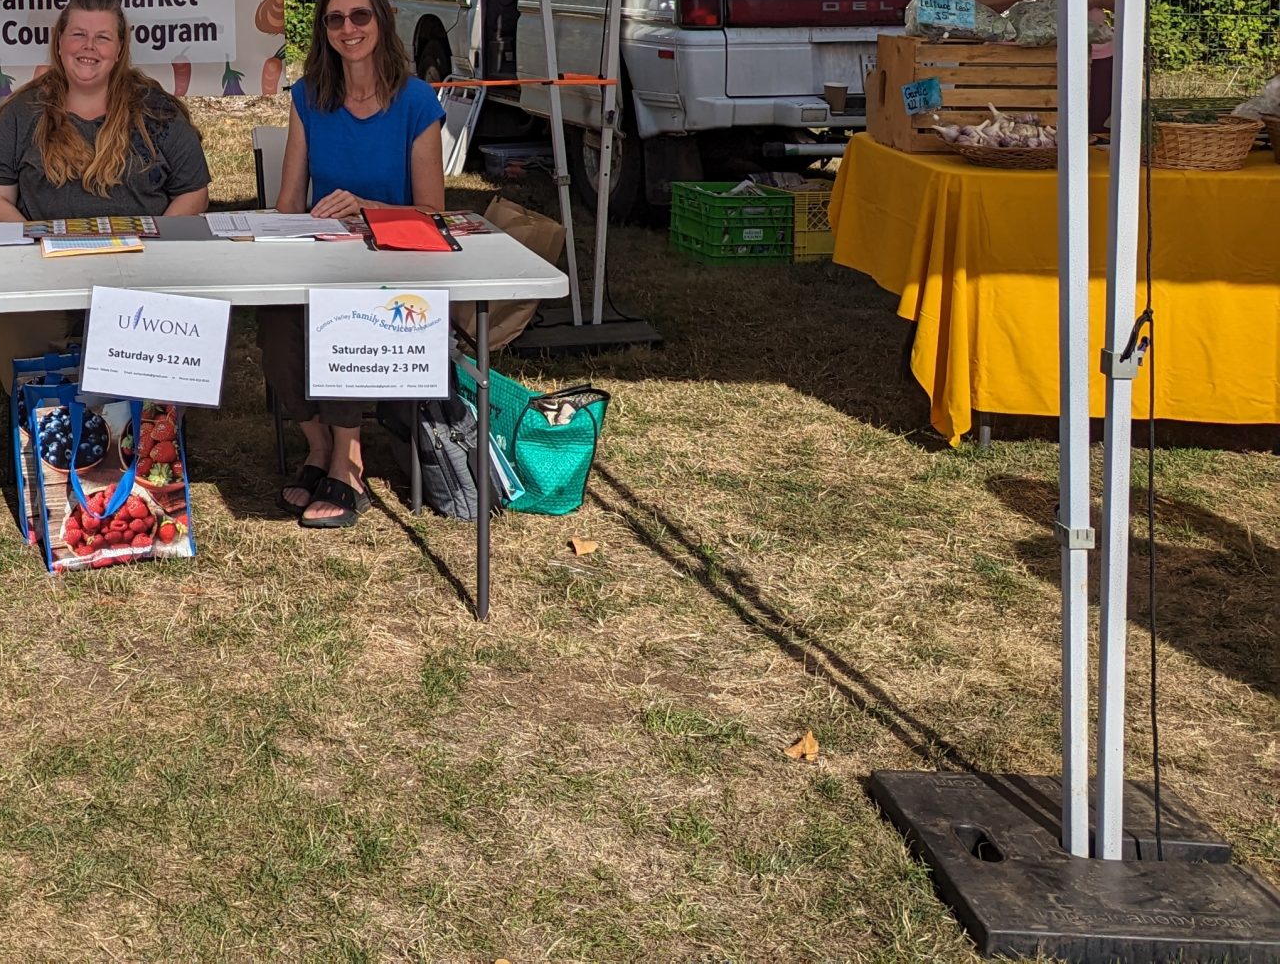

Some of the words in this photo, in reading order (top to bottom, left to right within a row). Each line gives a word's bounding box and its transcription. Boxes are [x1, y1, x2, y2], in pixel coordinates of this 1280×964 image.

[2, 20, 50, 45] Cou
[904, 87, 929, 100] Garlic
[351, 310, 380, 326] Family
[379, 319, 412, 333] Services
[108, 347, 154, 364] Saturday
[157, 353, 180, 365] 9-12
[182, 356, 201, 367] AM
[332, 344, 379, 356] Saturday
[381, 345, 404, 355] 9-11
[407, 345, 425, 354] AM
[329, 363, 390, 374] Wednesday
[392, 363, 409, 372] 2-3
[412, 363, 429, 372] PM
